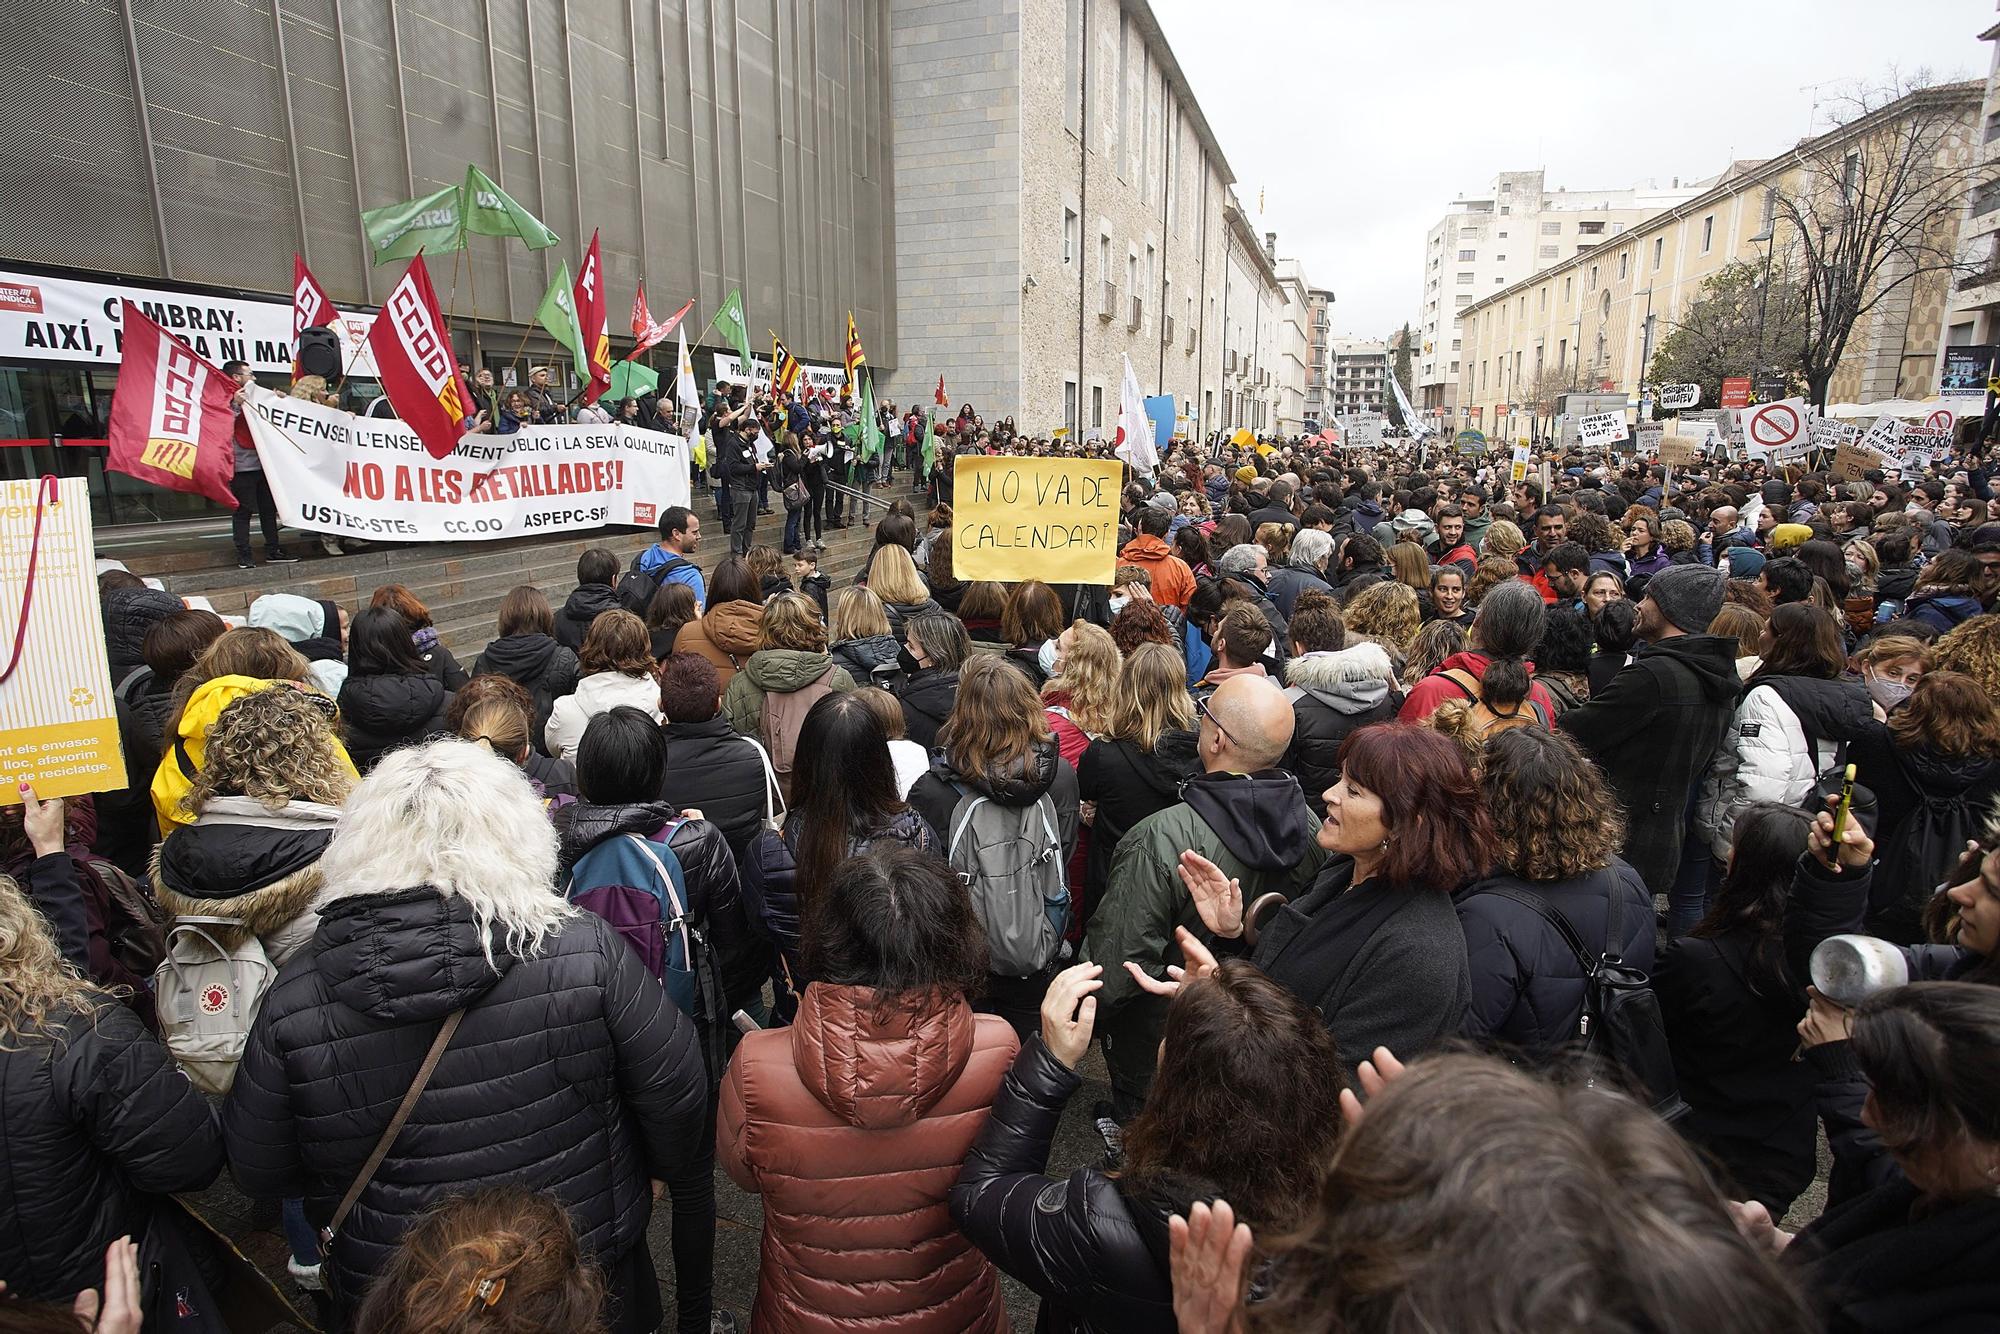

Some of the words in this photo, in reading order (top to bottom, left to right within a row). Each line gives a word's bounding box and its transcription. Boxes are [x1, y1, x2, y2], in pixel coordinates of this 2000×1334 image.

[103, 297, 243, 333] CMBRAY:
[25, 319, 103, 357] AIXÍ,
[219, 337, 246, 361] NI
[255, 340, 294, 364] MA
[257, 403, 352, 443] DEFENSEN
[564, 437, 582, 451] LA
[586, 435, 619, 450] SEVA
[623, 436, 676, 457] QUALITAT
[343, 461, 385, 501] NO
[395, 465, 414, 501] A
[418, 467, 463, 505] LES
[469, 460, 624, 504] RETALLADES!
[976, 470, 1020, 504] NO
[1082, 477, 1110, 508] DE
[3, 759, 34, 770] lloc,
[37, 750, 98, 767] afavorim
[17, 744, 38, 755] els
[41, 737, 99, 752] envasos
[18, 772, 36, 782] de
[39, 763, 112, 780] reciclatge.
